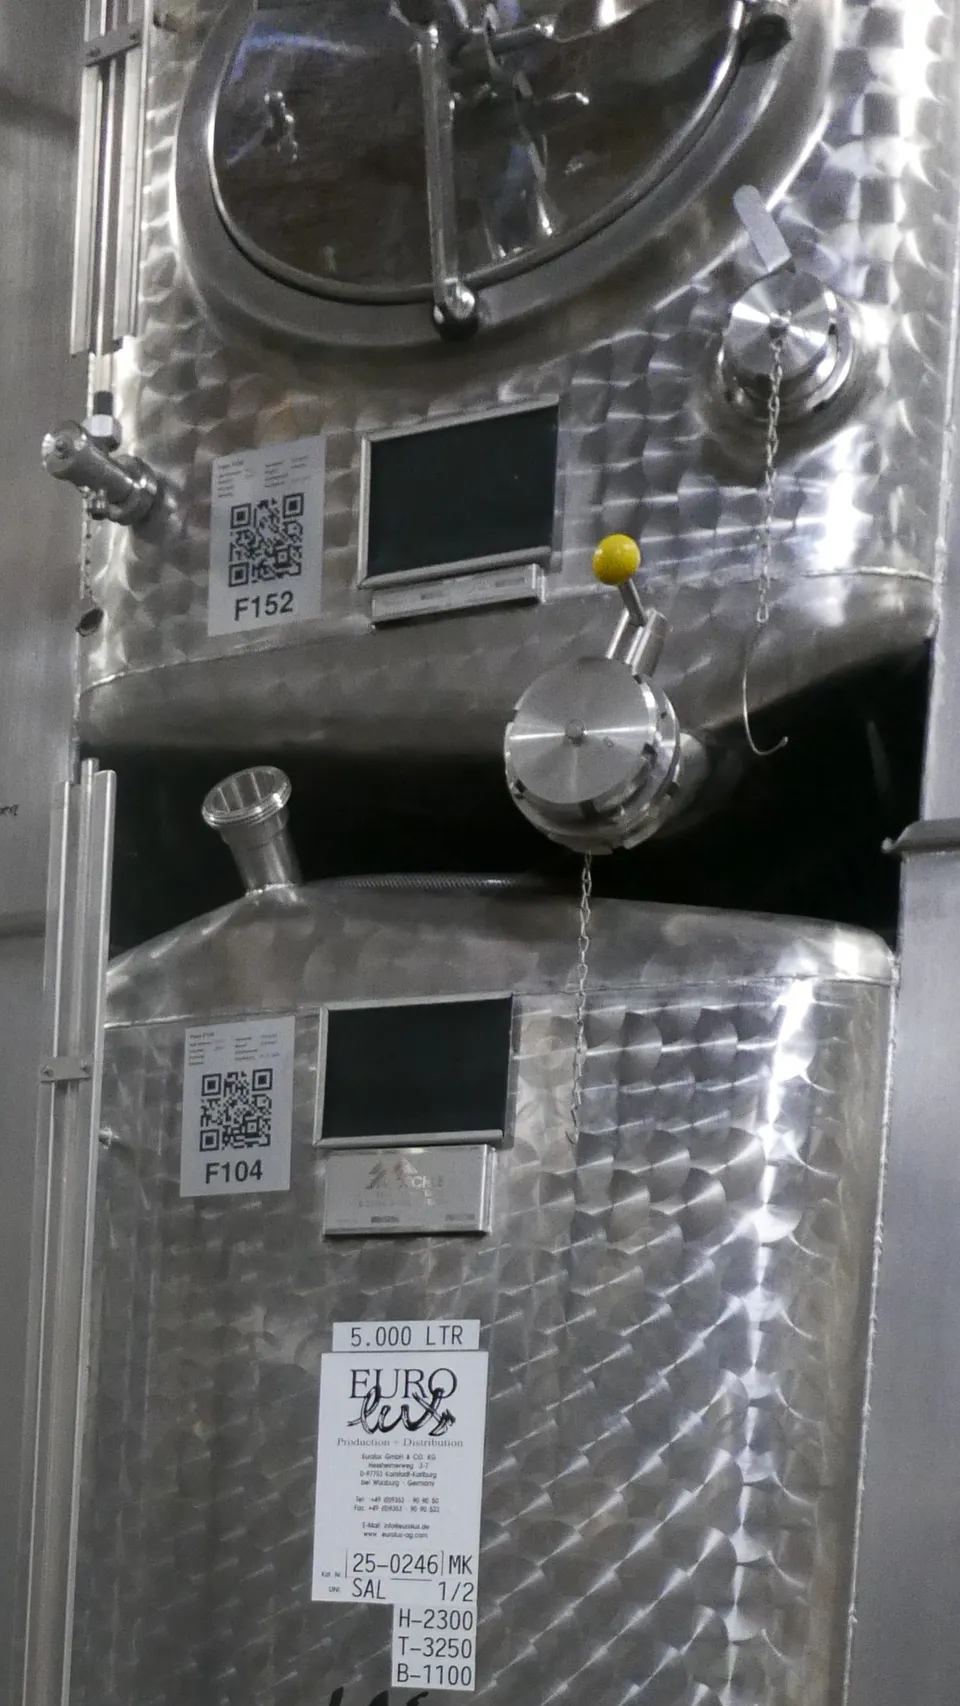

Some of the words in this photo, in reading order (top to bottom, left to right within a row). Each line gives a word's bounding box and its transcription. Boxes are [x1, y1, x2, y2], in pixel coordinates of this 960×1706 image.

[234, 591, 294, 622] F152
[205, 1159, 263, 1184] F104
[351, 1325, 412, 1347] 5.000
[426, 1325, 463, 1346] LTR
[349, 1367, 458, 1400] EURO
[337, 1437, 390, 1447] Production
[403, 1437, 463, 1447] Distribution
[352, 1552, 439, 1575] 25-0246
[448, 1554, 473, 1575] MK
[351, 1577, 386, 1600] SAL
[438, 1581, 474, 1602] 1/2
[398, 1608, 473, 1631] H-2300
[397, 1636, 472, 1659] T-3250
[396, 1663, 472, 1686] B-1100
